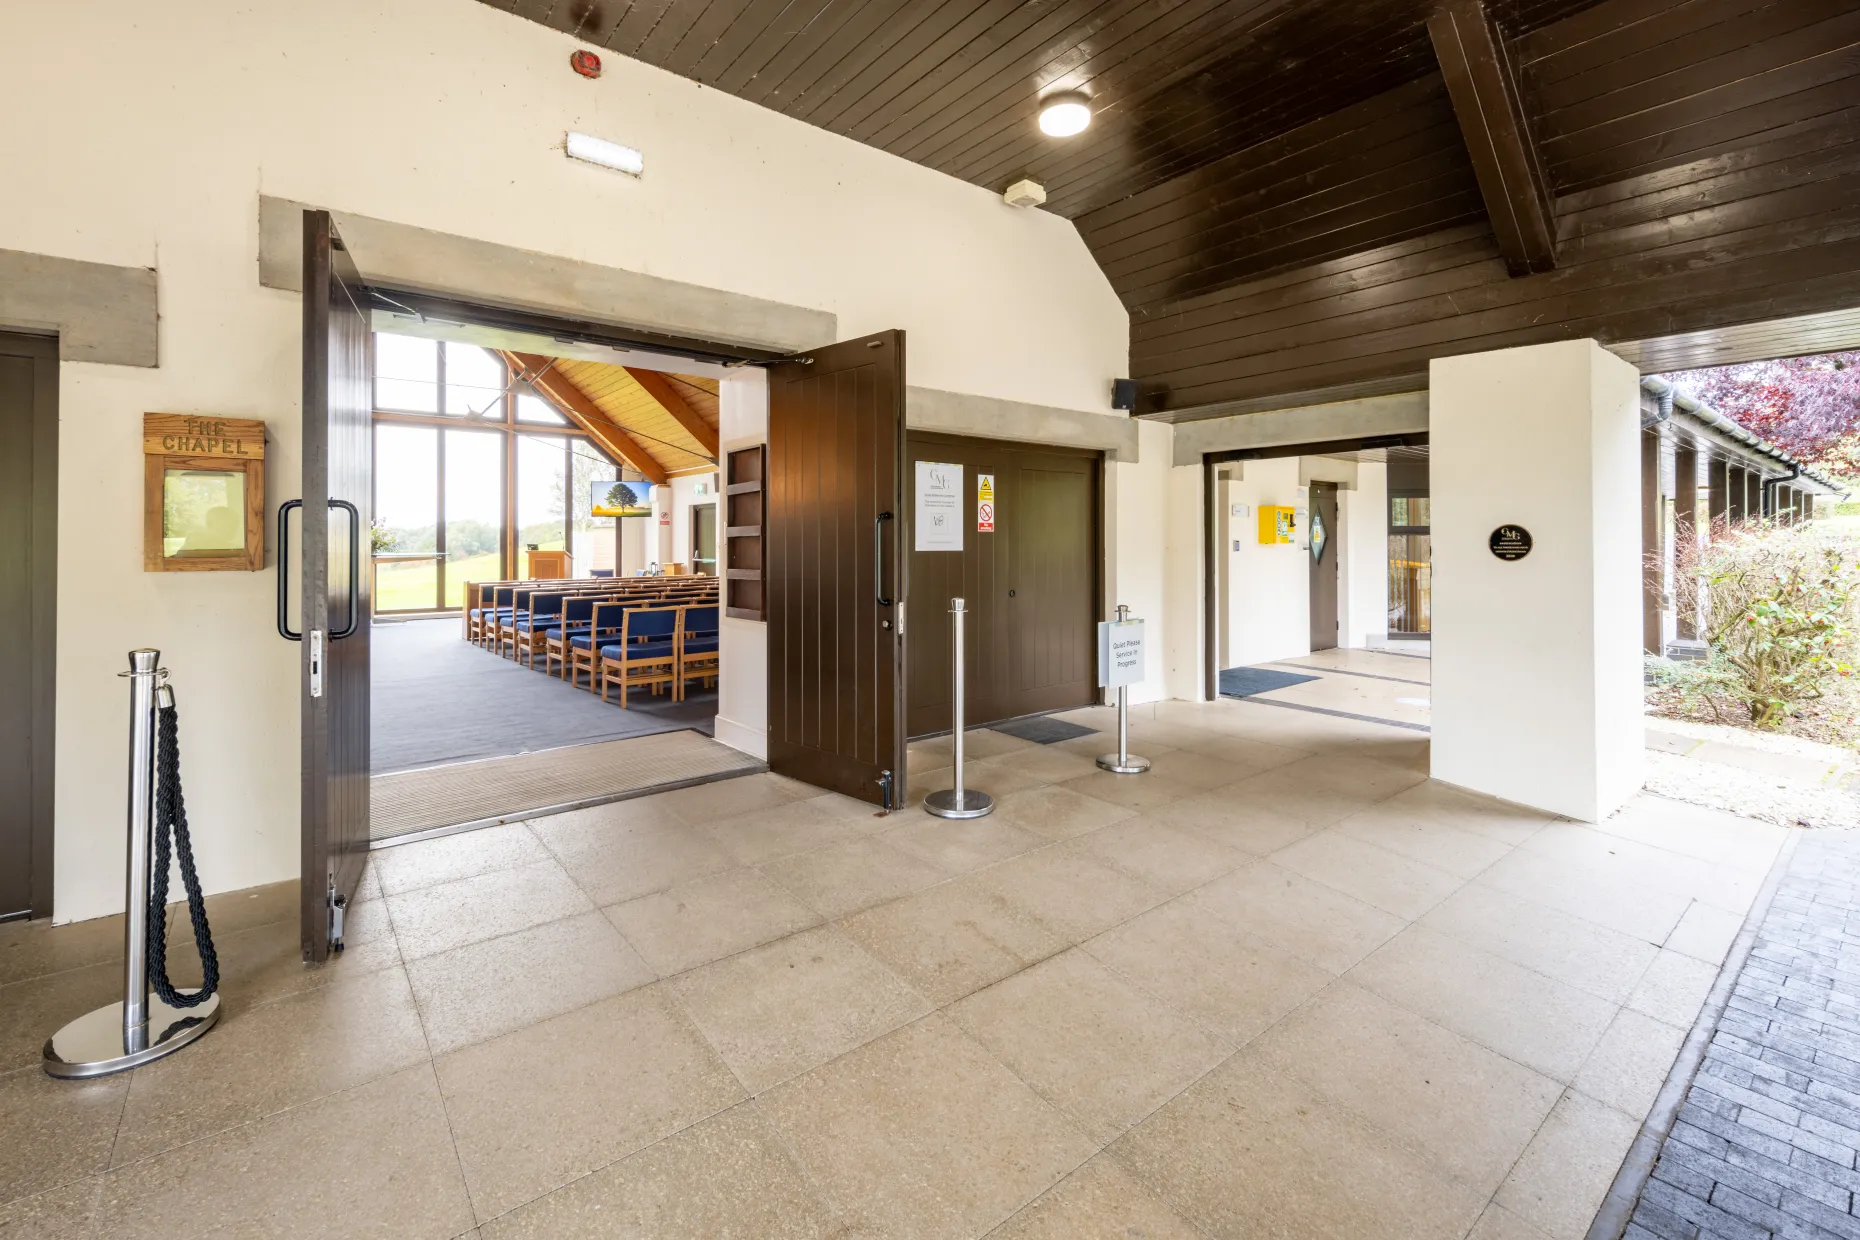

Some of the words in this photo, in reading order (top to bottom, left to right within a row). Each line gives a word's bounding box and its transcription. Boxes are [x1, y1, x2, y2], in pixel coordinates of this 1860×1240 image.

[184, 420, 226, 436] THE
[162, 436, 248, 454] CHAPEL
[1117, 660, 1136, 668] Progress
